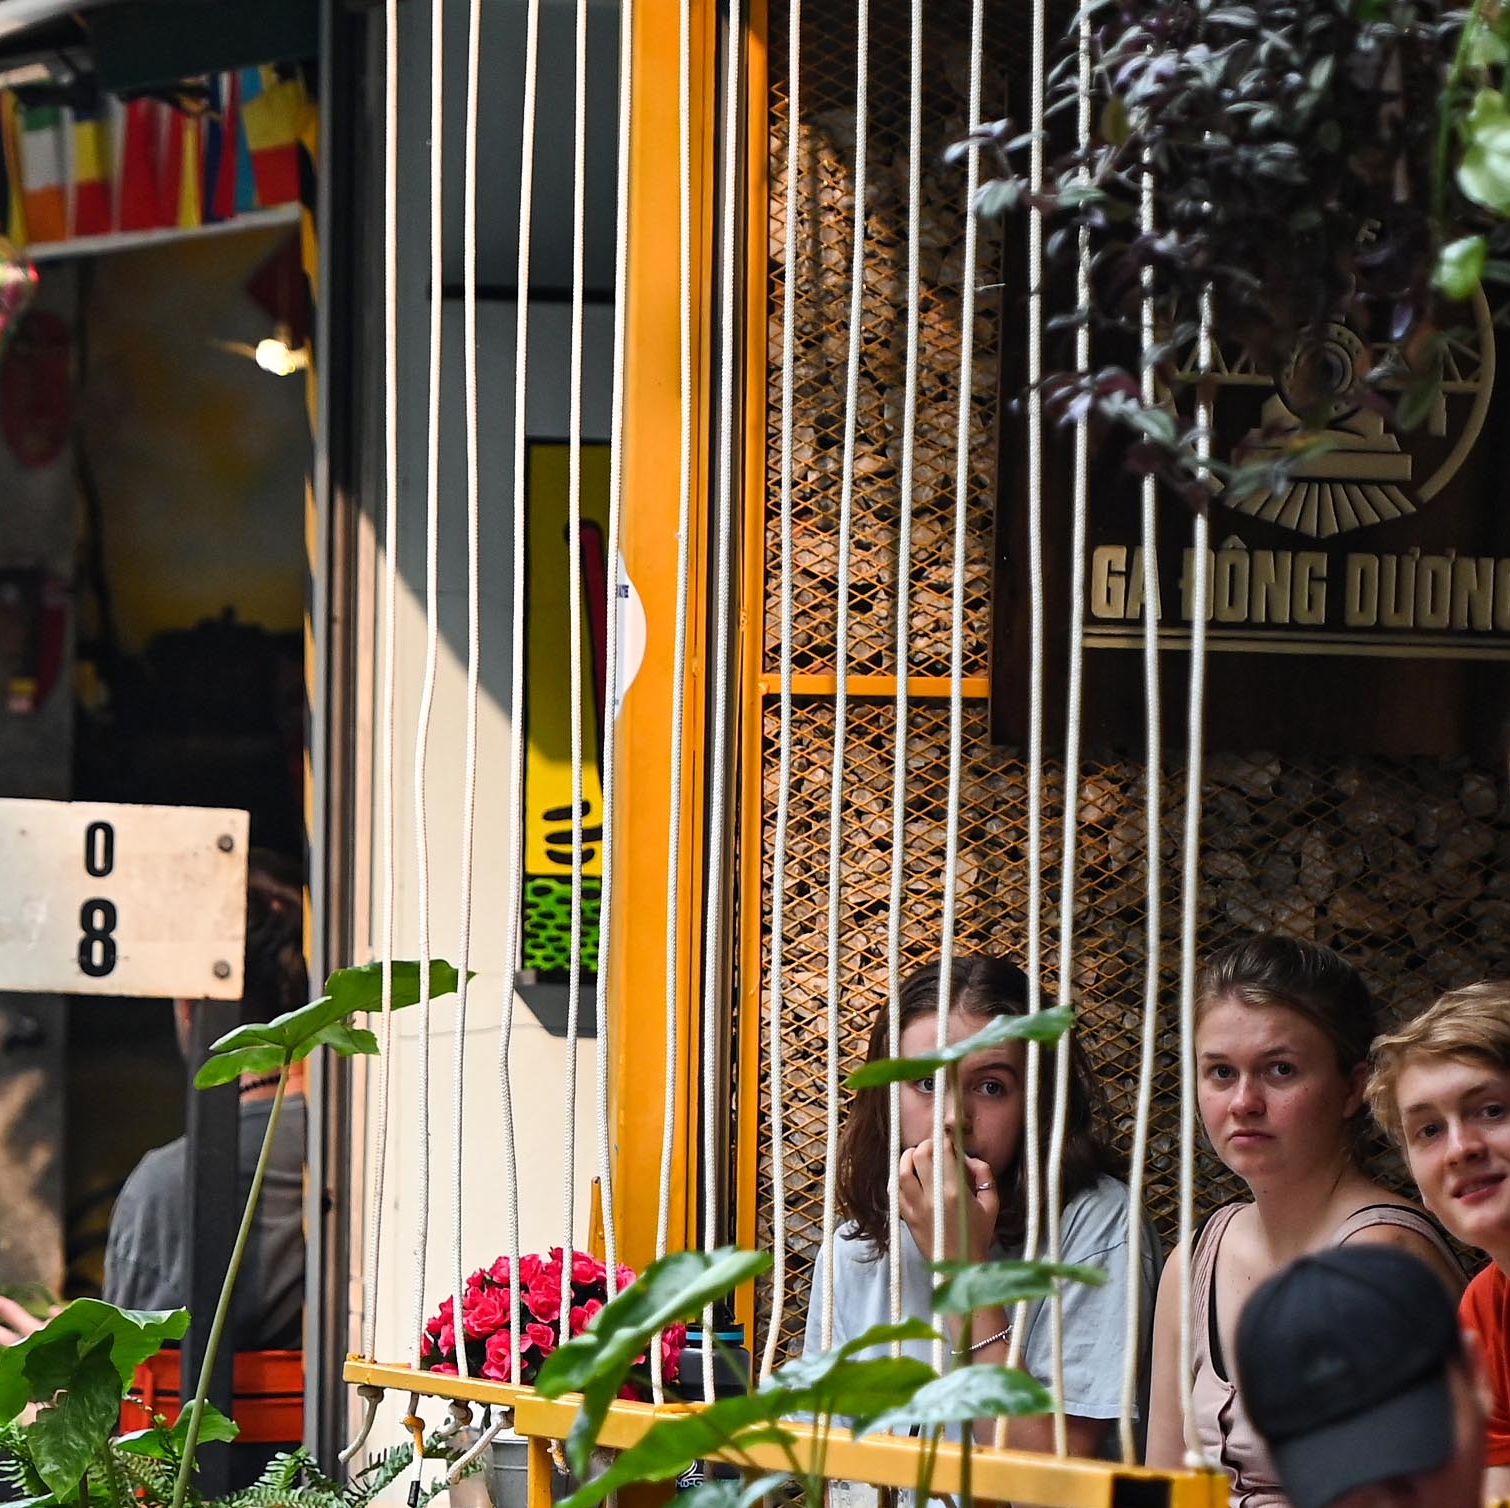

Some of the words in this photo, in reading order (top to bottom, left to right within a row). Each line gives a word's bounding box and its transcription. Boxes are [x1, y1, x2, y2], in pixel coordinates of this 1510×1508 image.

[1090, 545, 1162, 620] GA
[1180, 534, 1327, 625] ĐÔNG
[85, 821, 115, 878] 0
[78, 898, 117, 977] 8
